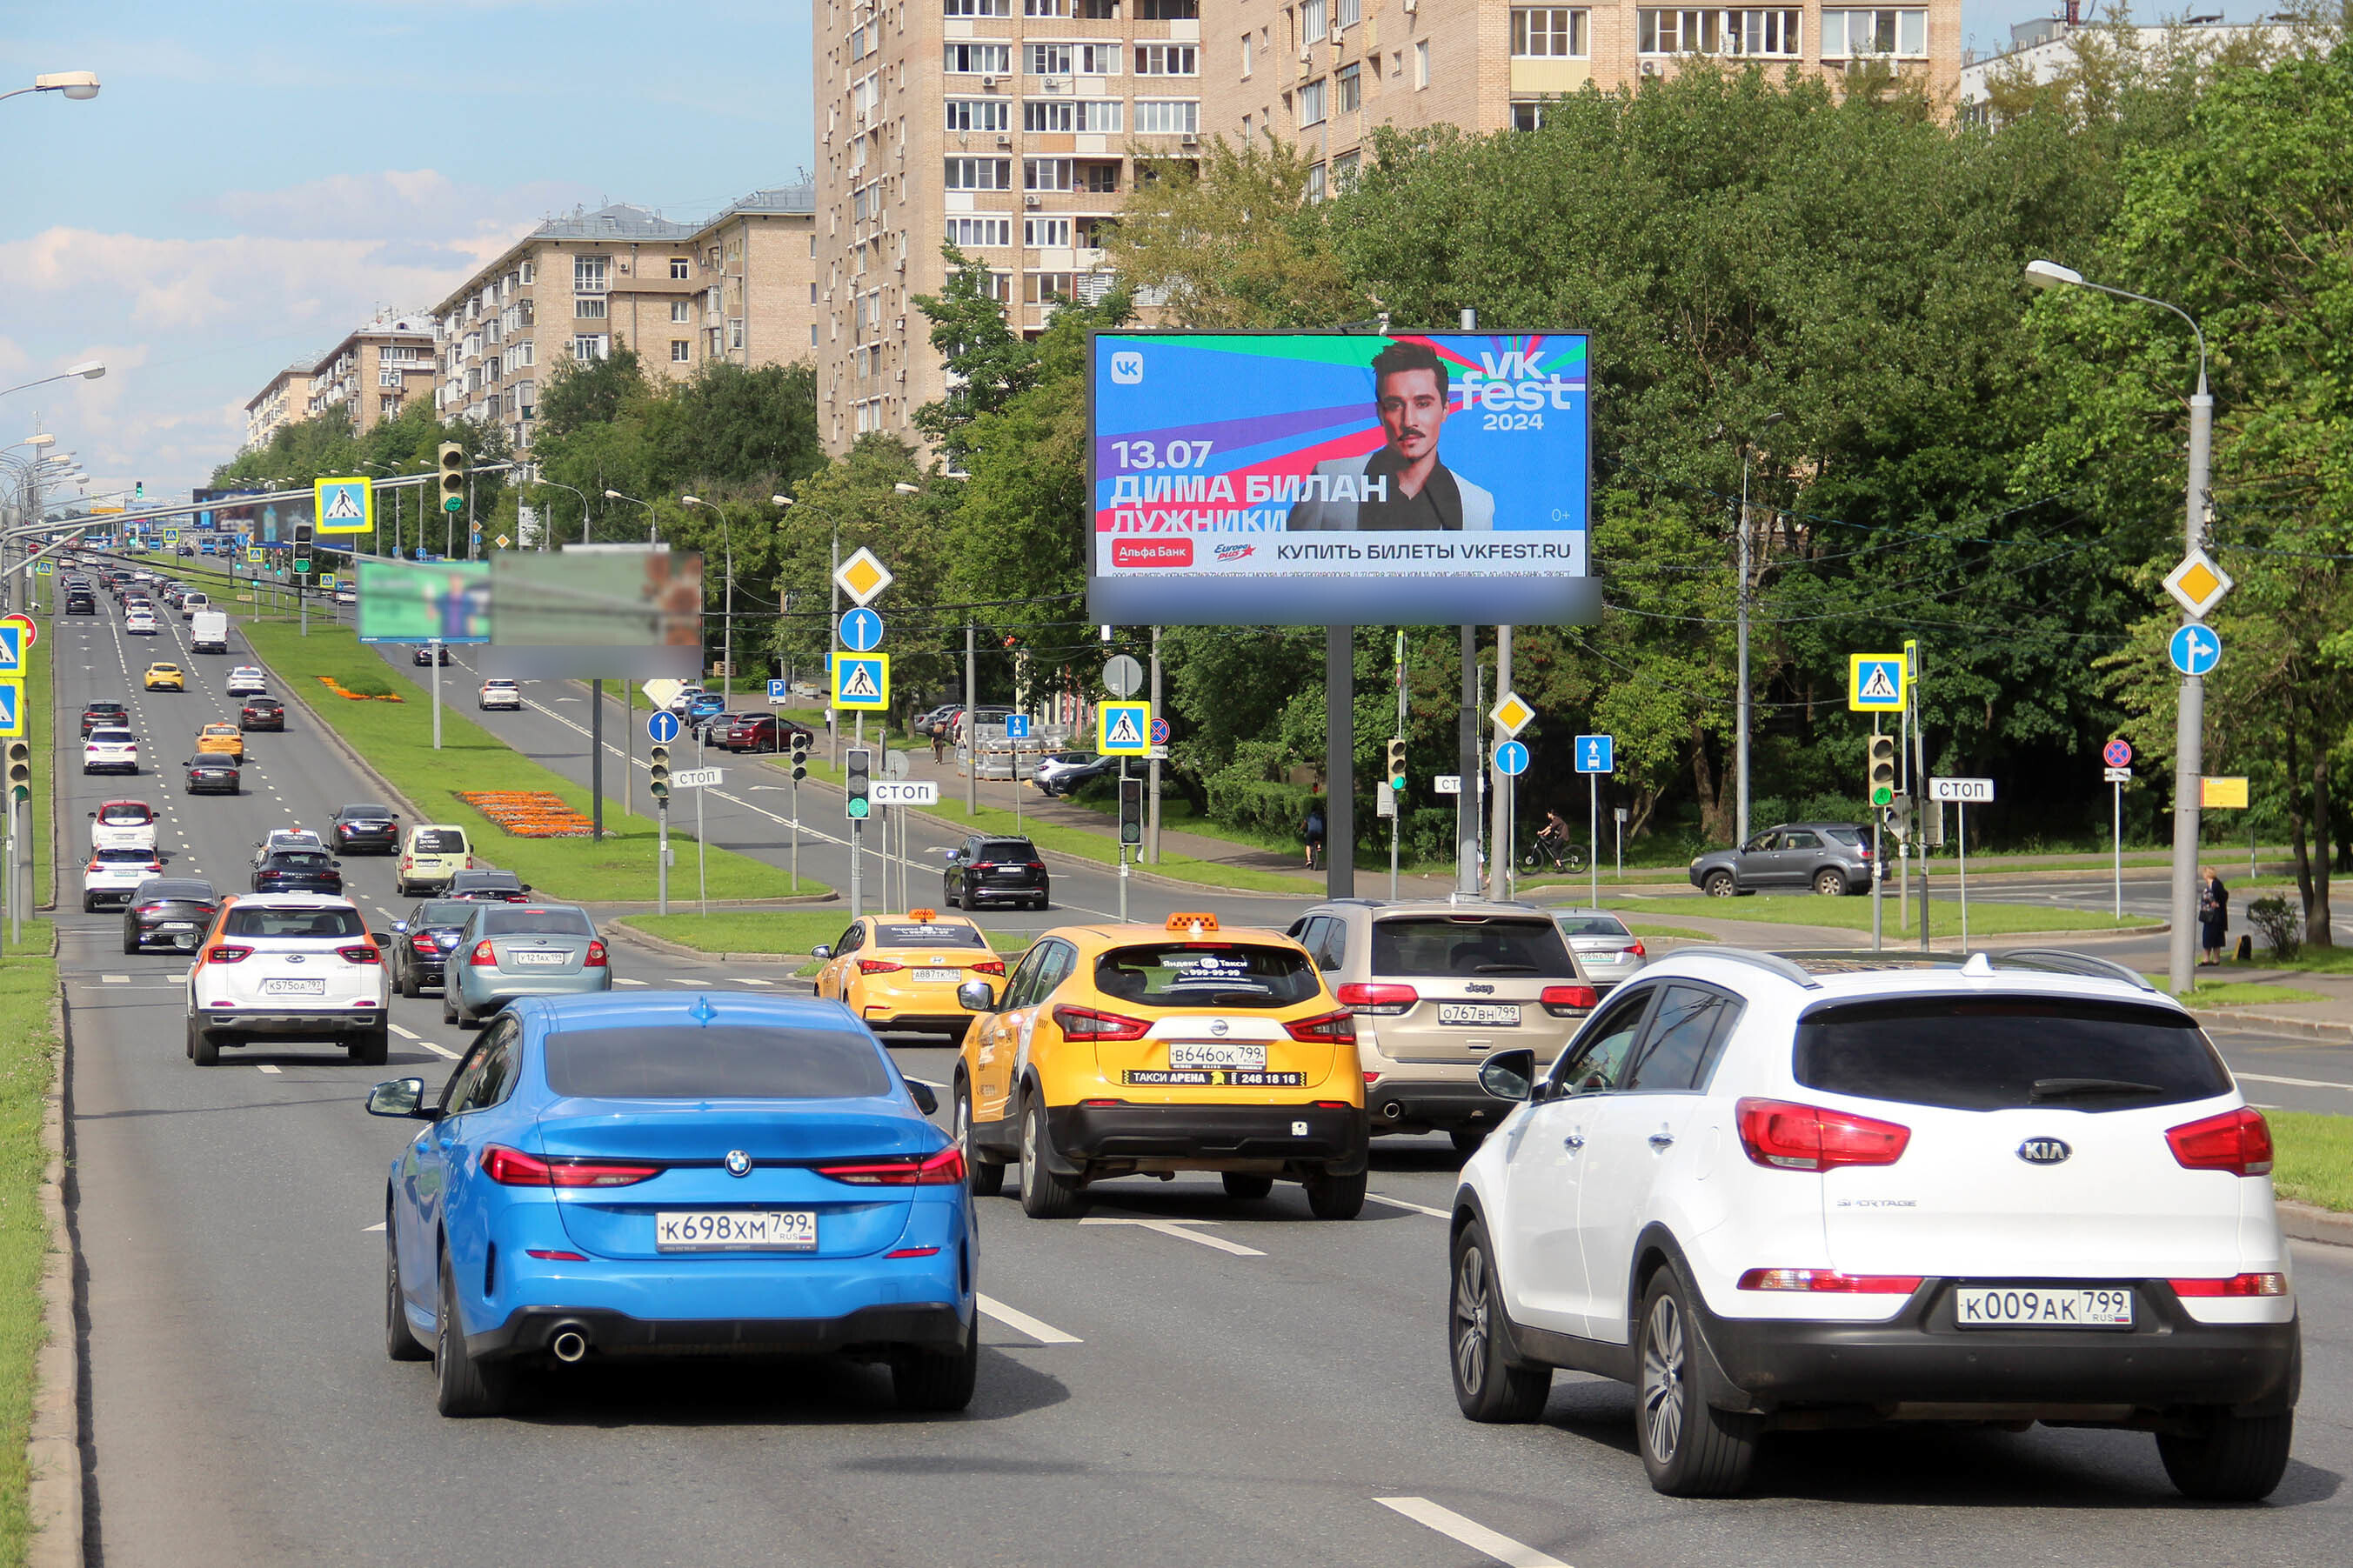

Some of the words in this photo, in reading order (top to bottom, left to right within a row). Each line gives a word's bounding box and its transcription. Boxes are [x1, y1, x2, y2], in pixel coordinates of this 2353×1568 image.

[1116, 361, 1139, 376] VK
[1481, 351, 1547, 379] VK
[1450, 370, 1583, 410] fest
[1483, 413, 1544, 430] 2024
[1111, 440, 1213, 469] 13.07
[1110, 475, 1236, 508] ДИМА
[1246, 475, 1387, 503] БИЛАН
[1111, 510, 1287, 532] ЛУЖНИКИ
[1552, 508, 1570, 522] 0+
[1119, 546, 1156, 560] Альфа
[1158, 546, 1187, 557] Банк
[1214, 544, 1248, 553] Europa
[1277, 544, 1361, 559] КУПИТЬ
[1367, 544, 1454, 558] БИЛЕТЫ
[1461, 544, 1571, 558] VKFEST.RU
[679, 771, 716, 785] СТОП
[876, 785, 929, 799] СТОП
[1940, 783, 1984, 797] СТОП
[1465, 983, 1495, 995] Jeep
[1443, 1006, 1494, 1020] О767ВН
[1496, 1006, 1515, 1017] 799
[1175, 1046, 1234, 1062] В646ОК
[1238, 1046, 1261, 1058] 799
[1133, 1072, 1167, 1082] ТАКСИ
[1170, 1073, 1206, 1083] АРЕНА
[1266, 1074, 1280, 1084] 18
[2025, 1142, 2065, 1159] KIA
[666, 1216, 765, 1240] К698ХМ
[771, 1213, 808, 1232] 799
[779, 1232, 799, 1241] RUS
[1966, 1291, 2076, 1320] К009АК
[2082, 1291, 2124, 1313] 799
